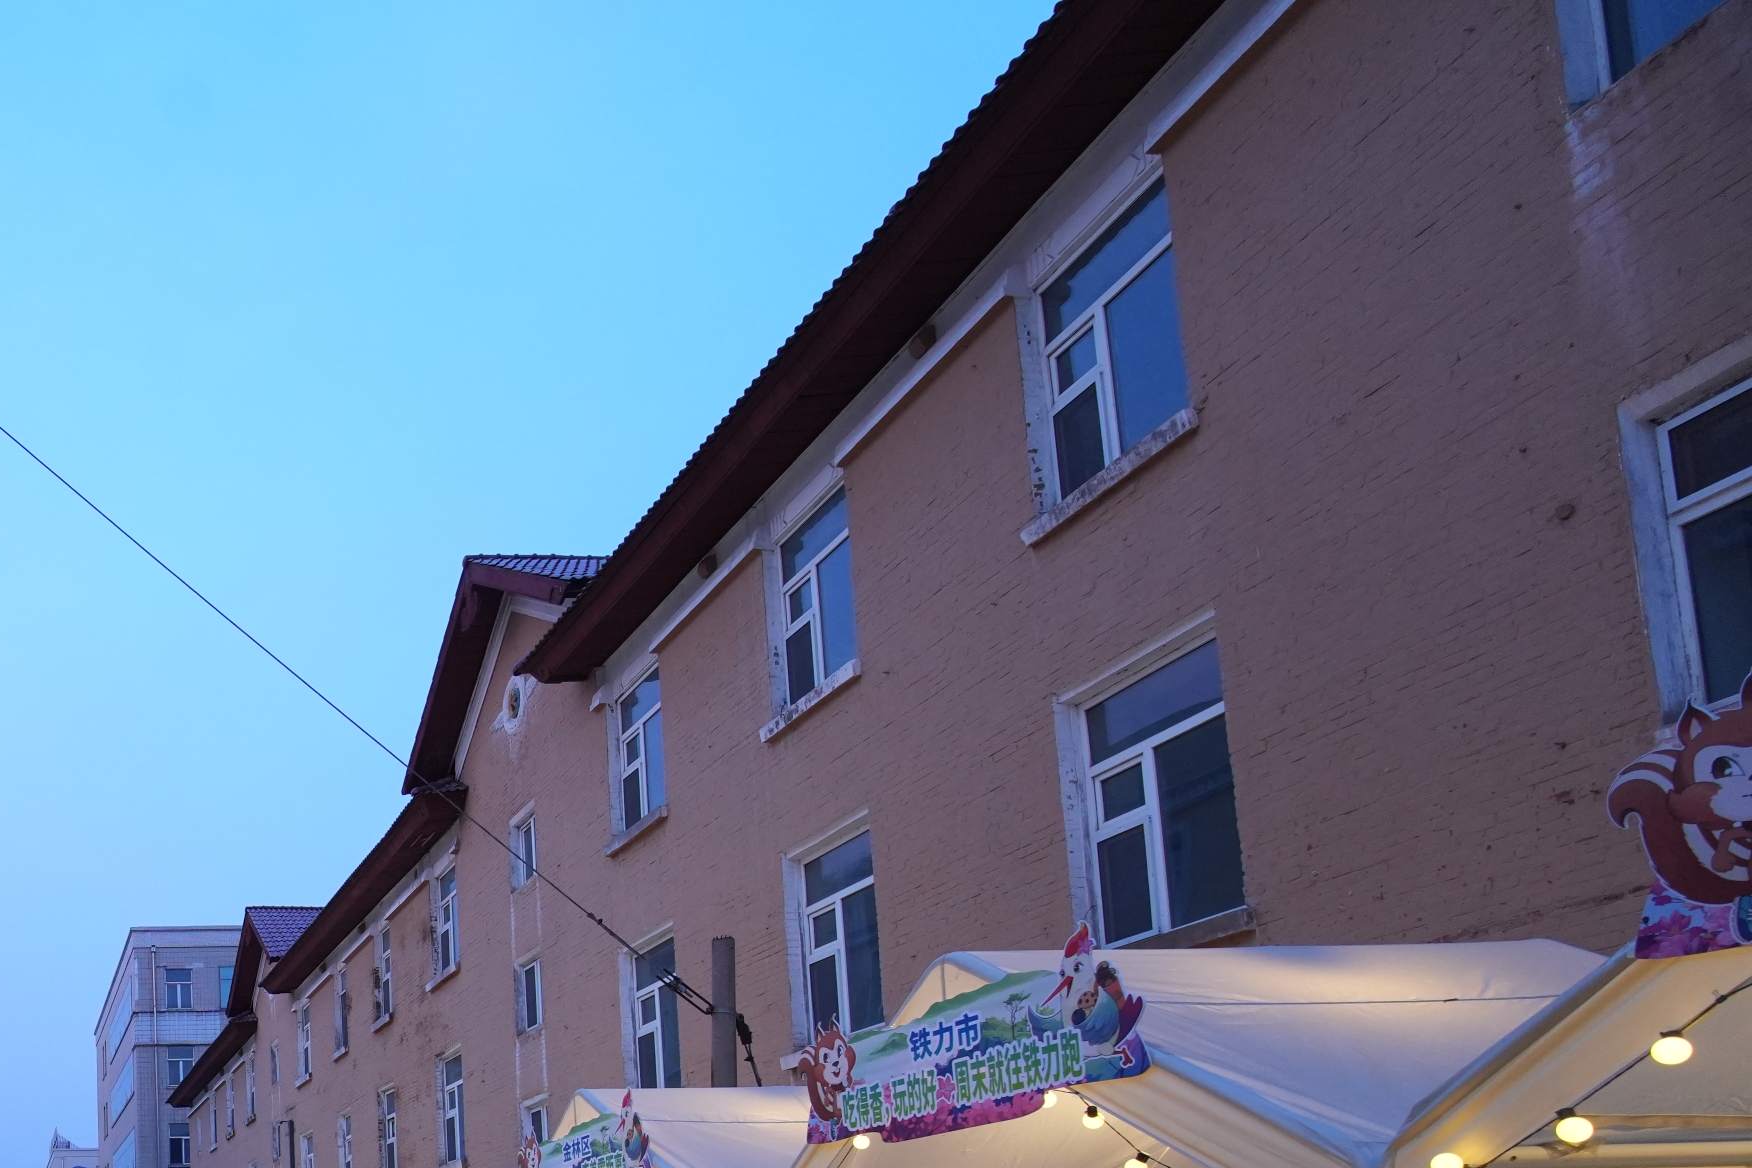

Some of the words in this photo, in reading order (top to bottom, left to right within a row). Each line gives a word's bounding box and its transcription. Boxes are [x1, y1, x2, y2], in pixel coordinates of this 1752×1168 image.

[909, 1013, 981, 1060] 铁力市
[954, 1030, 1084, 1104] 周末就往铁力跑
[563, 1135, 591, 1162] 金林区
